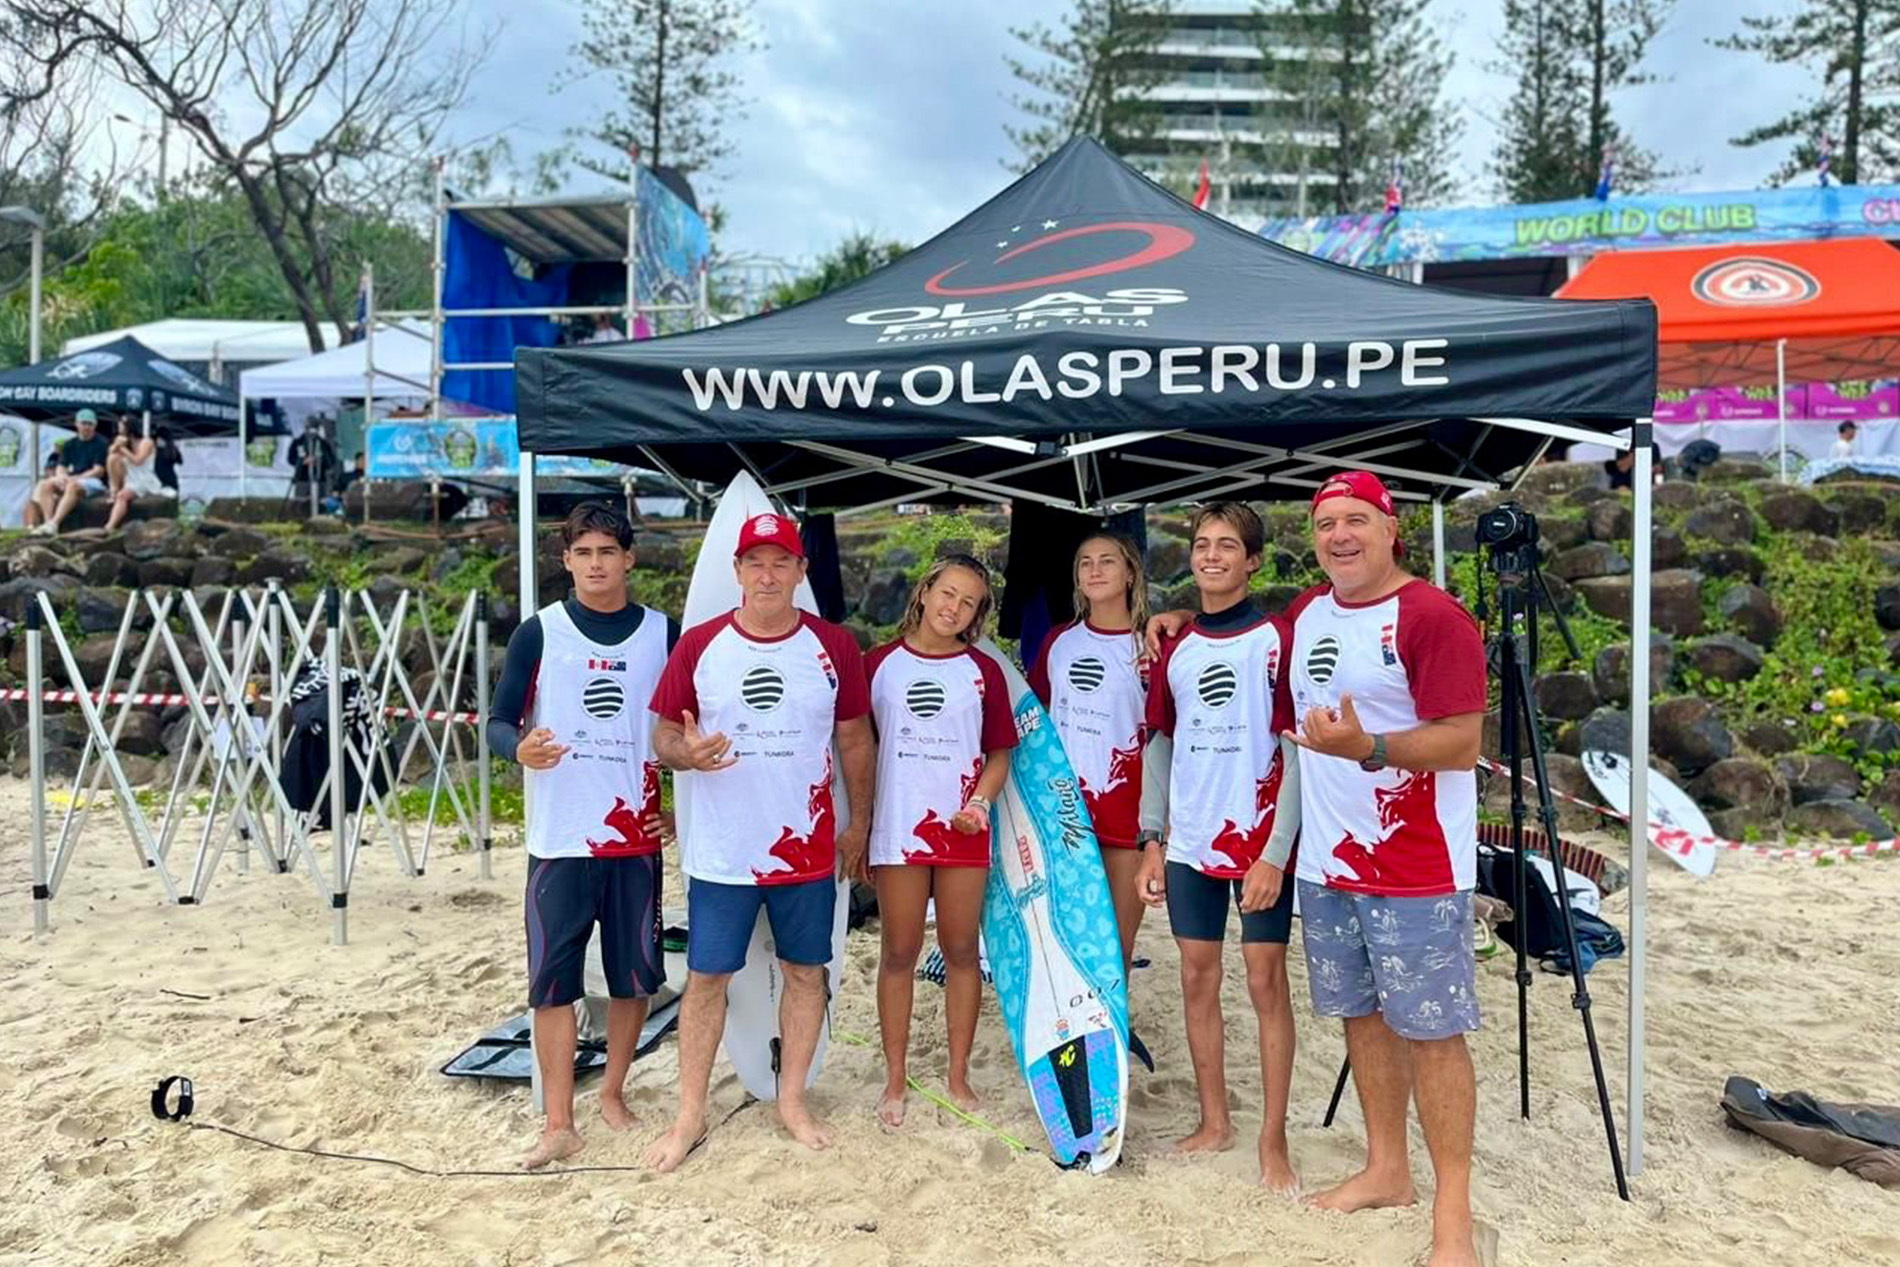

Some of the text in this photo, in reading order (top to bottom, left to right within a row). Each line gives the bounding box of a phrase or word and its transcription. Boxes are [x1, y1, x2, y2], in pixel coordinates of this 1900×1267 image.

[1515, 207, 1647, 245] WORLD
[1656, 202, 1757, 233] CLUB
[845, 288, 1189, 325] OLAS
[683, 338, 1450, 411] WWW.OLASPERU.PE
[1014, 706, 1040, 729] EAM
